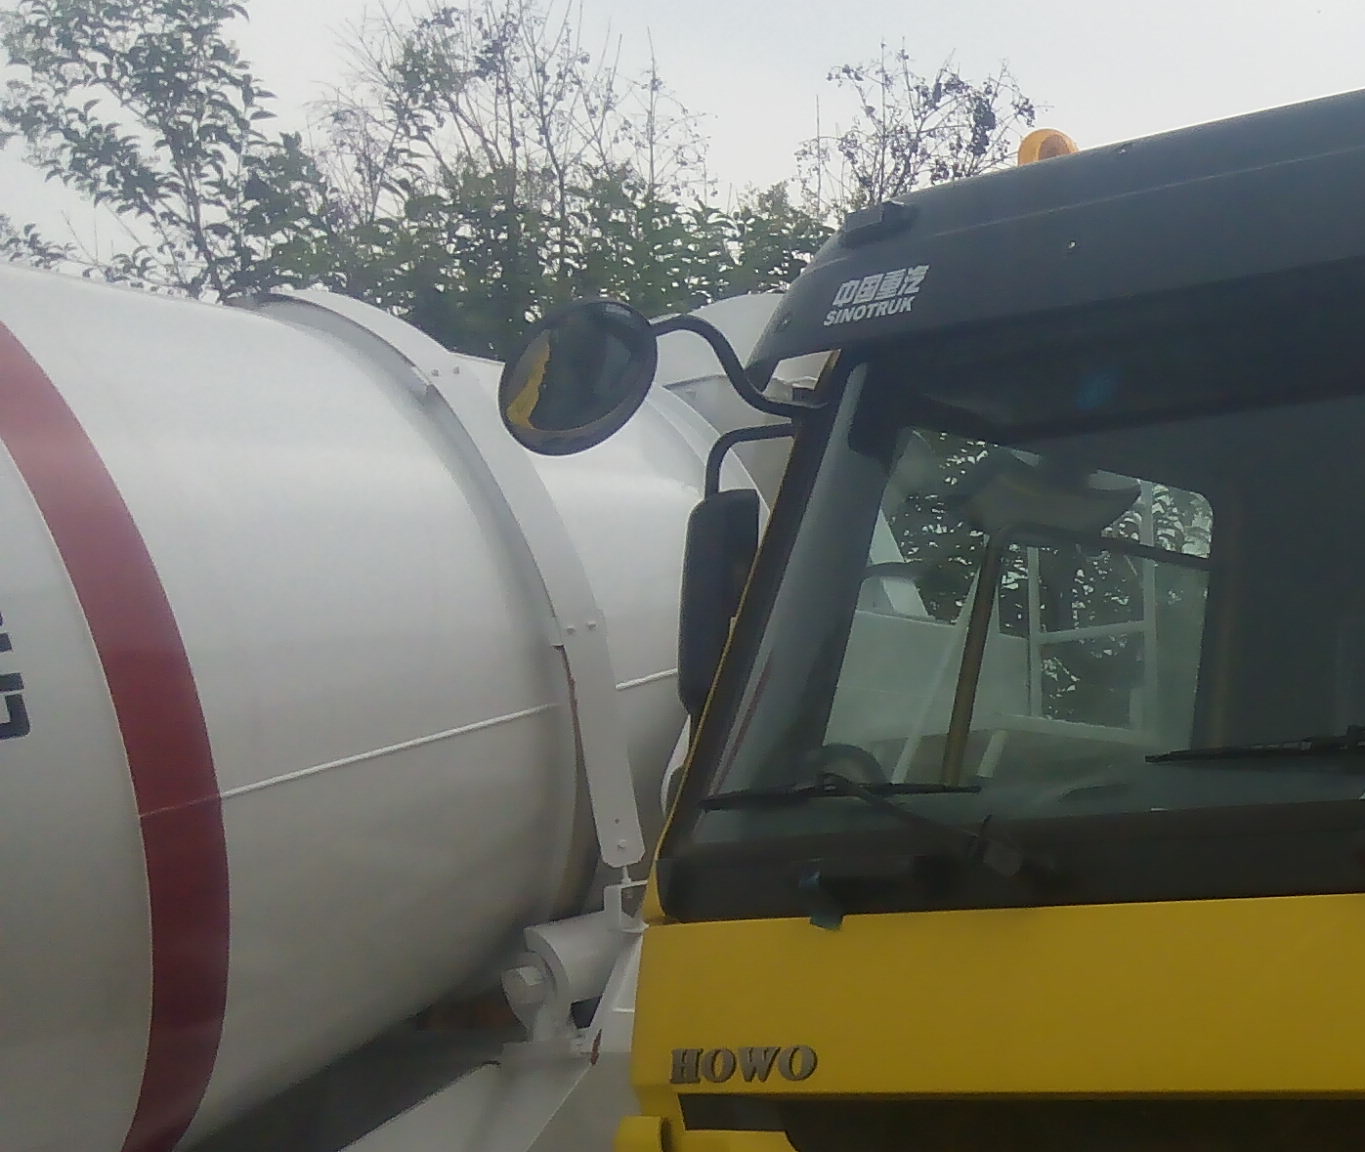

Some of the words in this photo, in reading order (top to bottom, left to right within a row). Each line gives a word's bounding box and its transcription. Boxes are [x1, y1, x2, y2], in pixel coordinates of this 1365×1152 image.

[832, 264, 929, 307] 中国重汽
[823, 296, 916, 326] SINOTRUK
[670, 1045, 818, 1084] HOWO
